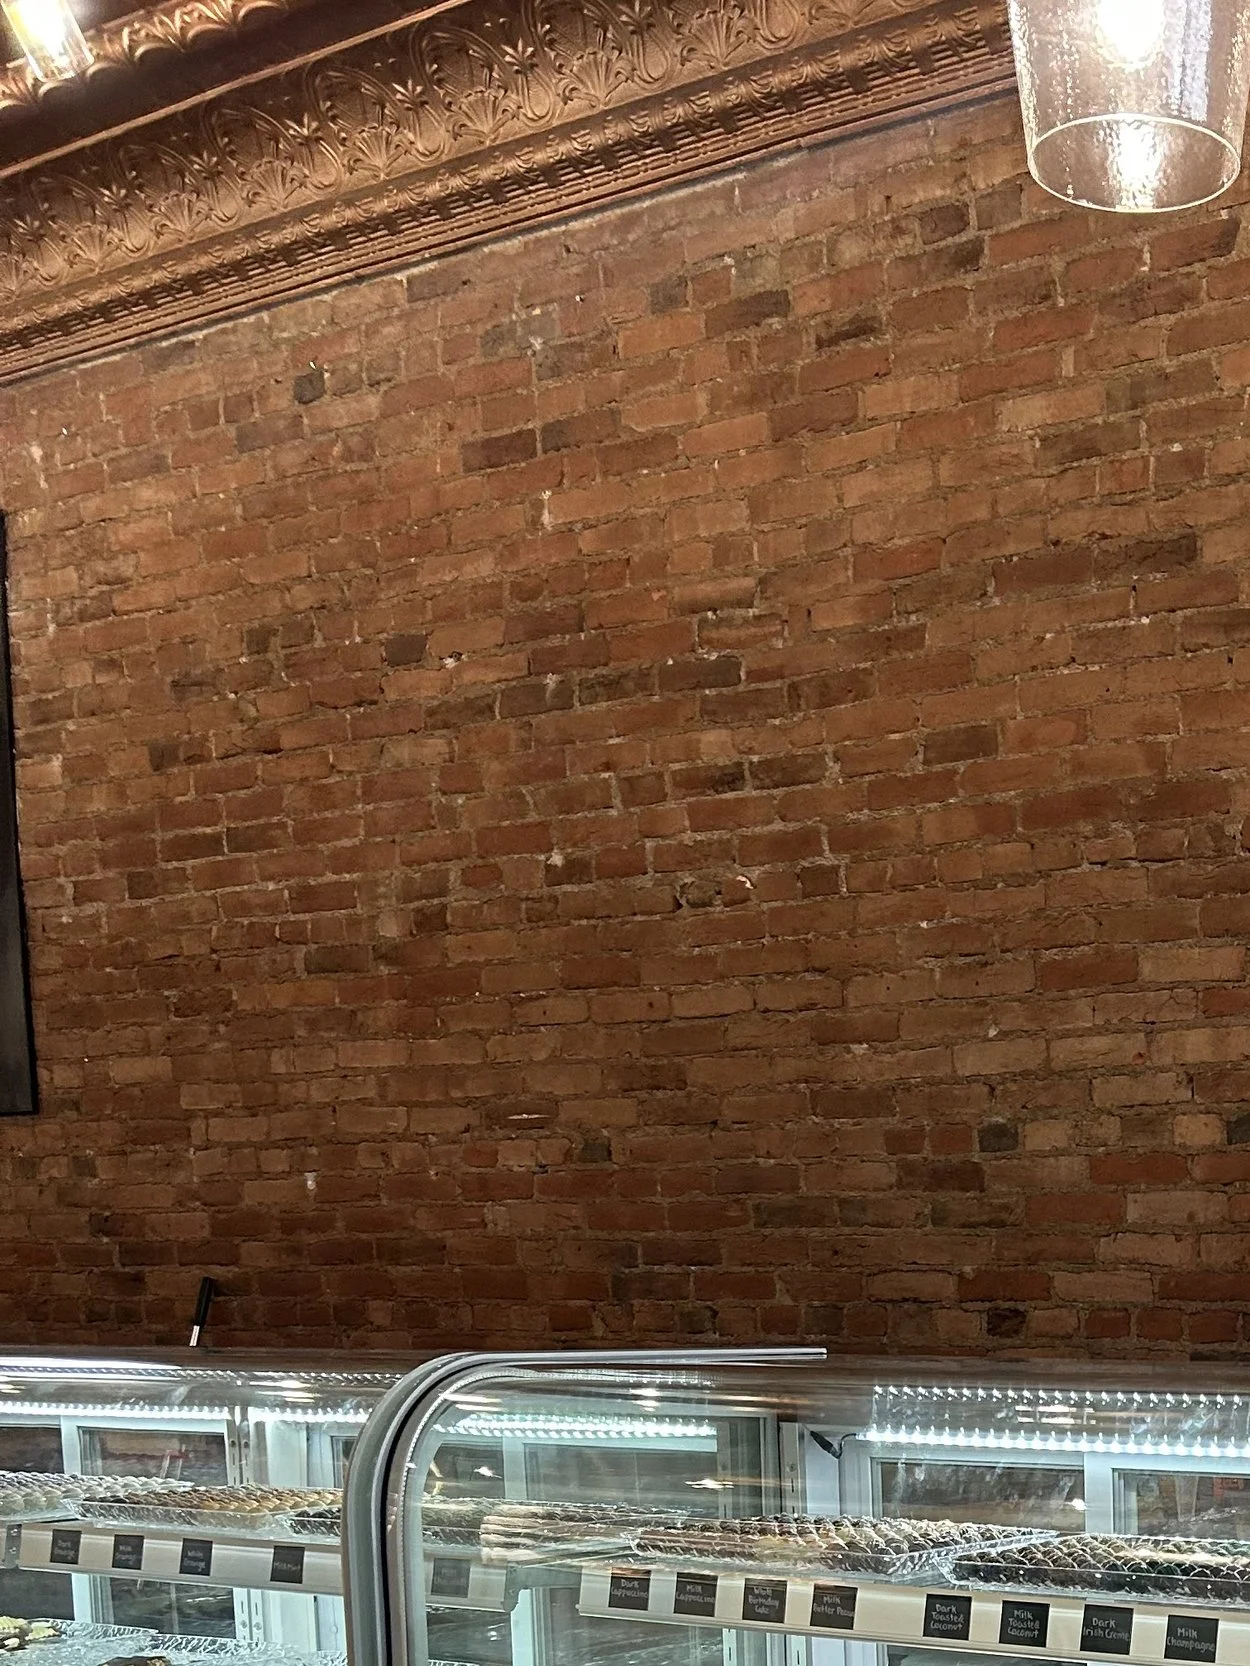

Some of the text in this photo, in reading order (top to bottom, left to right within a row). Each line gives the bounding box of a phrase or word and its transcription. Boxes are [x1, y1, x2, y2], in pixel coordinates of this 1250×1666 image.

[935, 1603, 957, 1613] Dark
[1013, 1609, 1033, 1620] Milk
[1092, 1617, 1116, 1629] Dark
[1177, 1627, 1198, 1639] Milk
